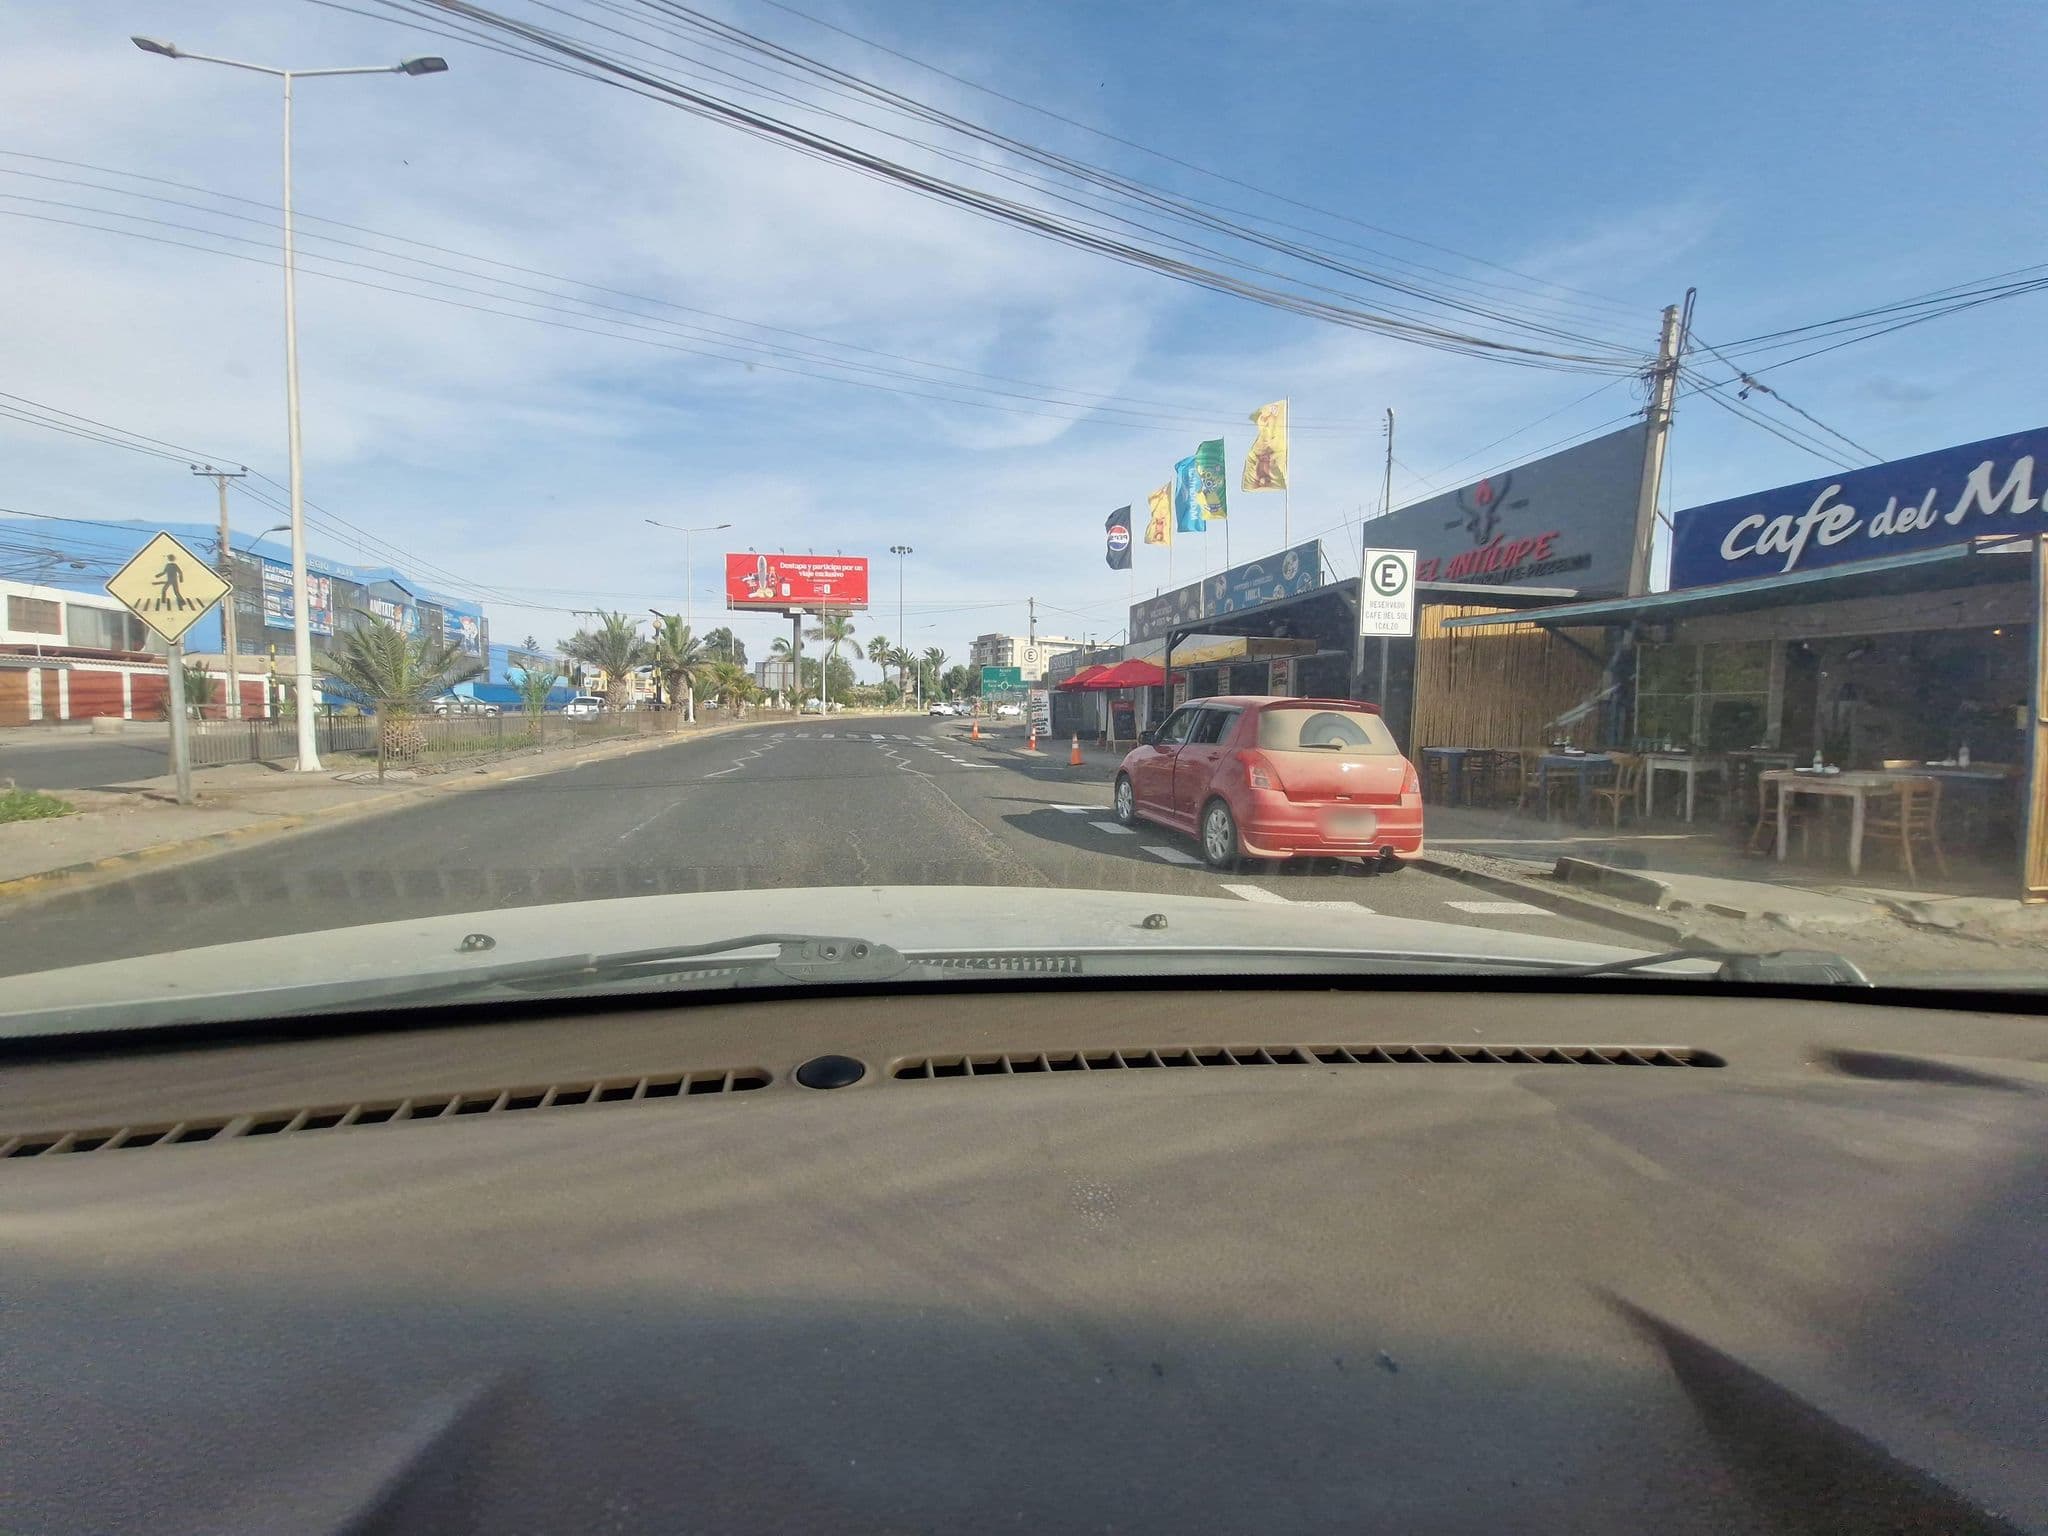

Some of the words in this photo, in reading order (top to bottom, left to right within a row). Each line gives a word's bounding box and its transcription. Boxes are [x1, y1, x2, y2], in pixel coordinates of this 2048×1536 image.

[1720, 484, 1863, 573] Cafe
[1868, 487, 1938, 538] del
[1944, 454, 2048, 526] M
[780, 562, 807, 570] Destapa
[812, 563, 842, 571] participa
[1381, 563, 1398, 587] E
[1365, 611, 1382, 620] CAFE
[1383, 611, 1395, 620] DEL
[1396, 612, 1409, 621] SOL
[1027, 650, 1035, 660] E
